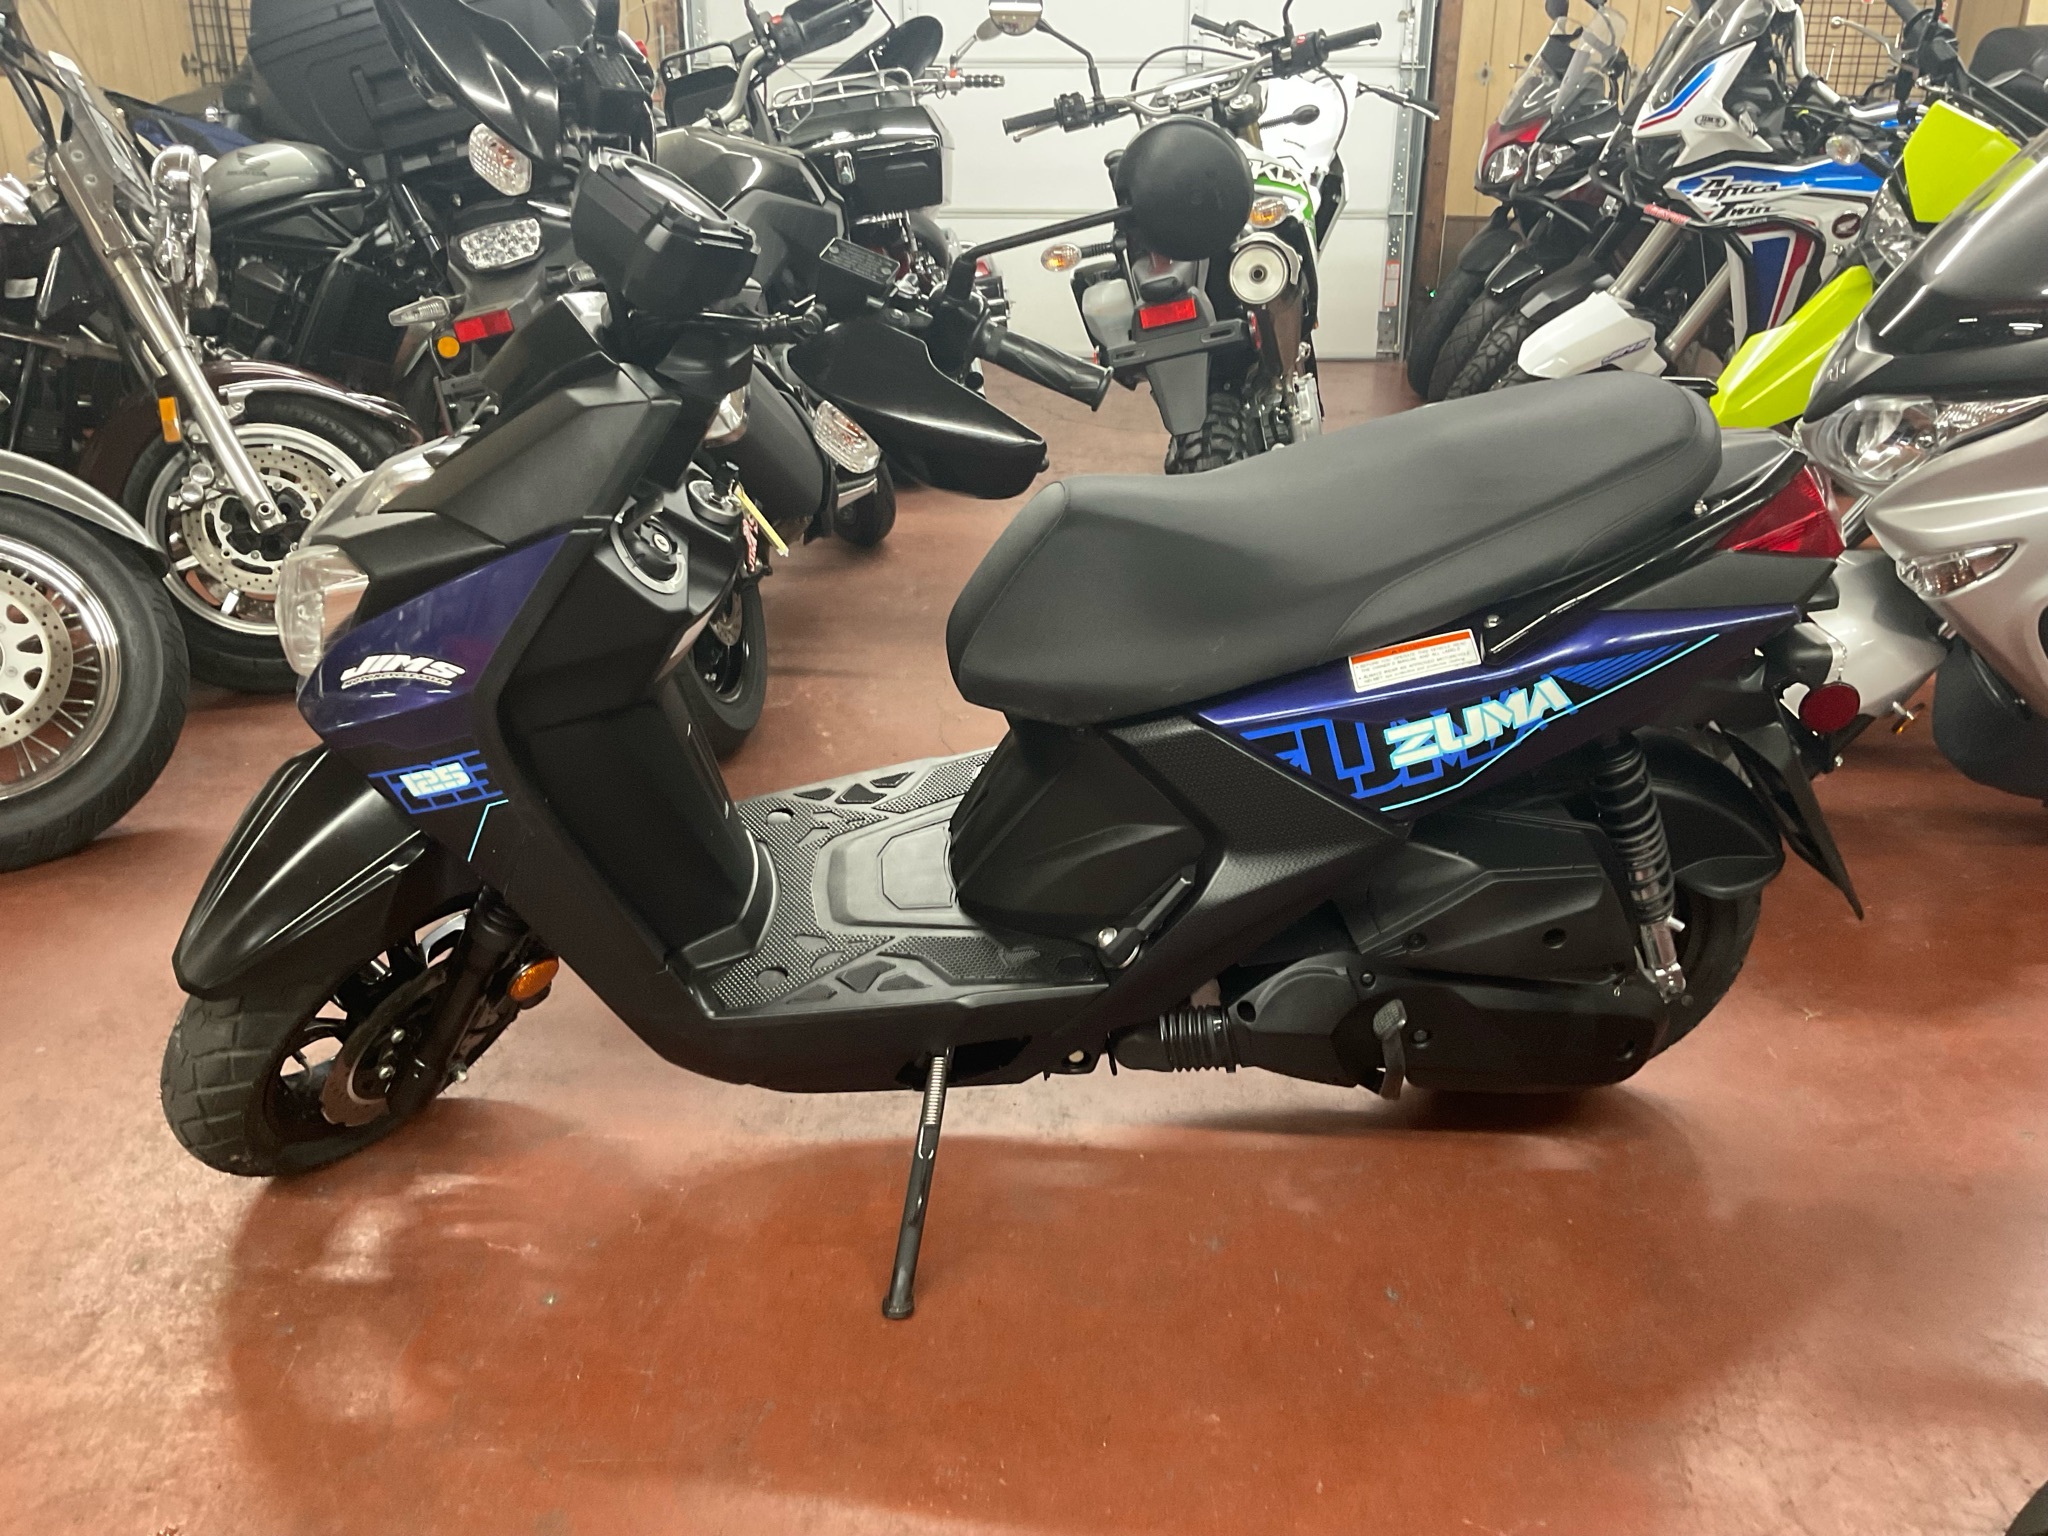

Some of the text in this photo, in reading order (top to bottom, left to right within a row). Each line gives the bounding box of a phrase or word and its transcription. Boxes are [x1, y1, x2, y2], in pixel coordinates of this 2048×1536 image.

[1692, 178, 1779, 202] Africa
[1709, 200, 1772, 220] Twin
[1383, 676, 1573, 770] ZUMA
[399, 762, 471, 797] 125
